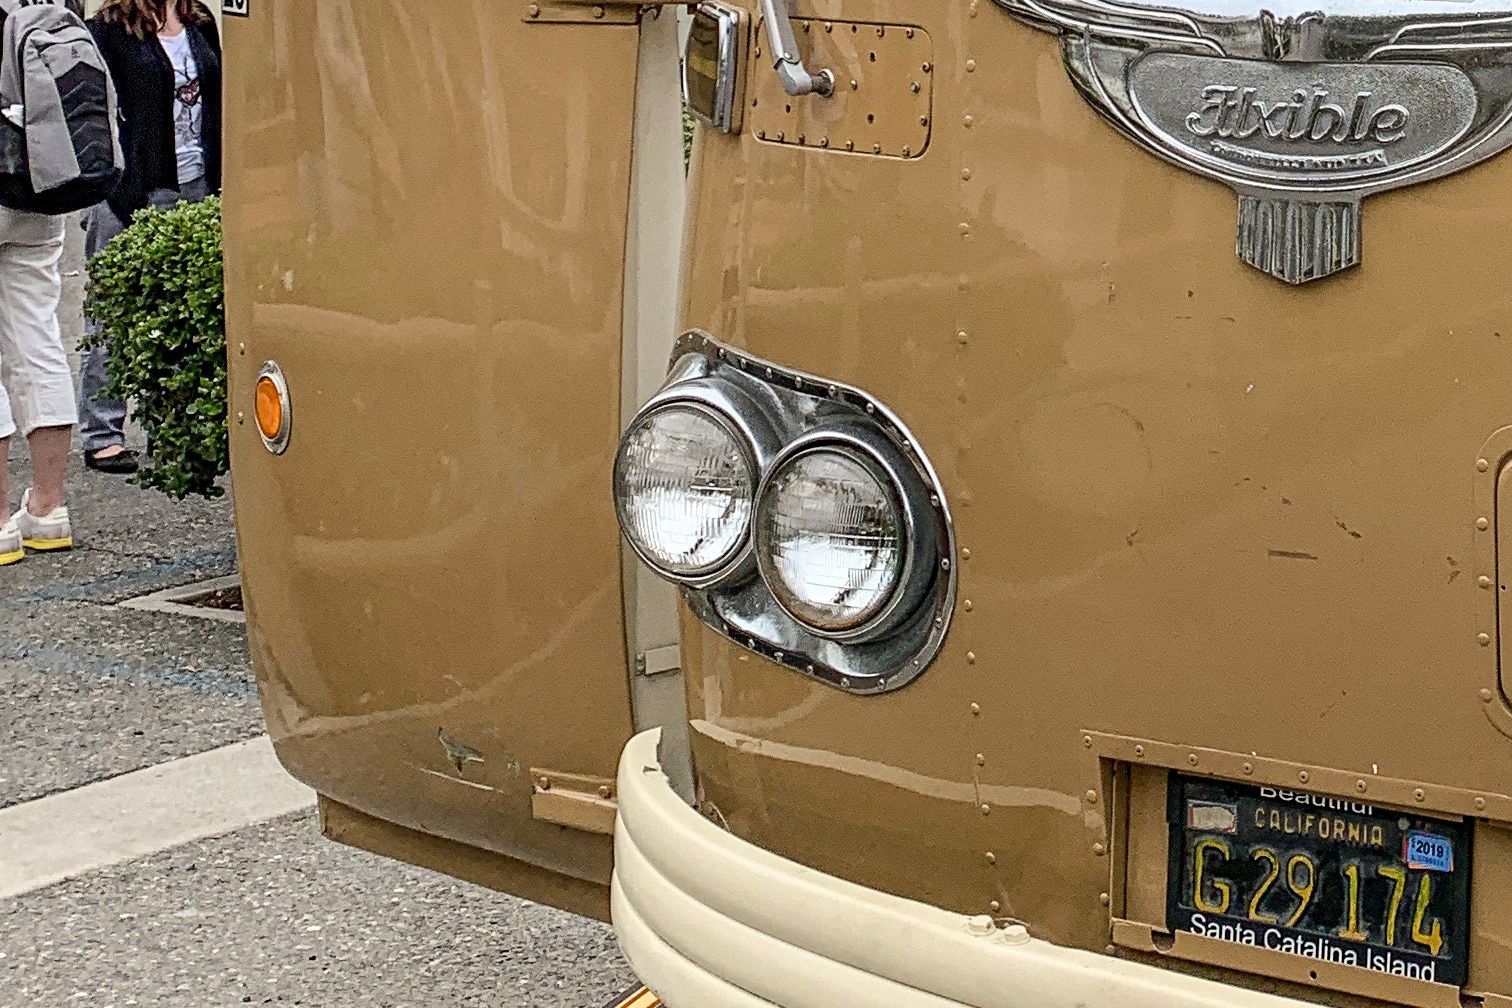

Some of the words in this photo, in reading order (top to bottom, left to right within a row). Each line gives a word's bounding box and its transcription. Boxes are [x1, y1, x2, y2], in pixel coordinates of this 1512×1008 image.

[1254, 808, 1383, 847] CALIFORNIA
[1190, 913, 1256, 948] Santa
[1263, 928, 1358, 966] Catalina
[1366, 947, 1436, 983] Island
